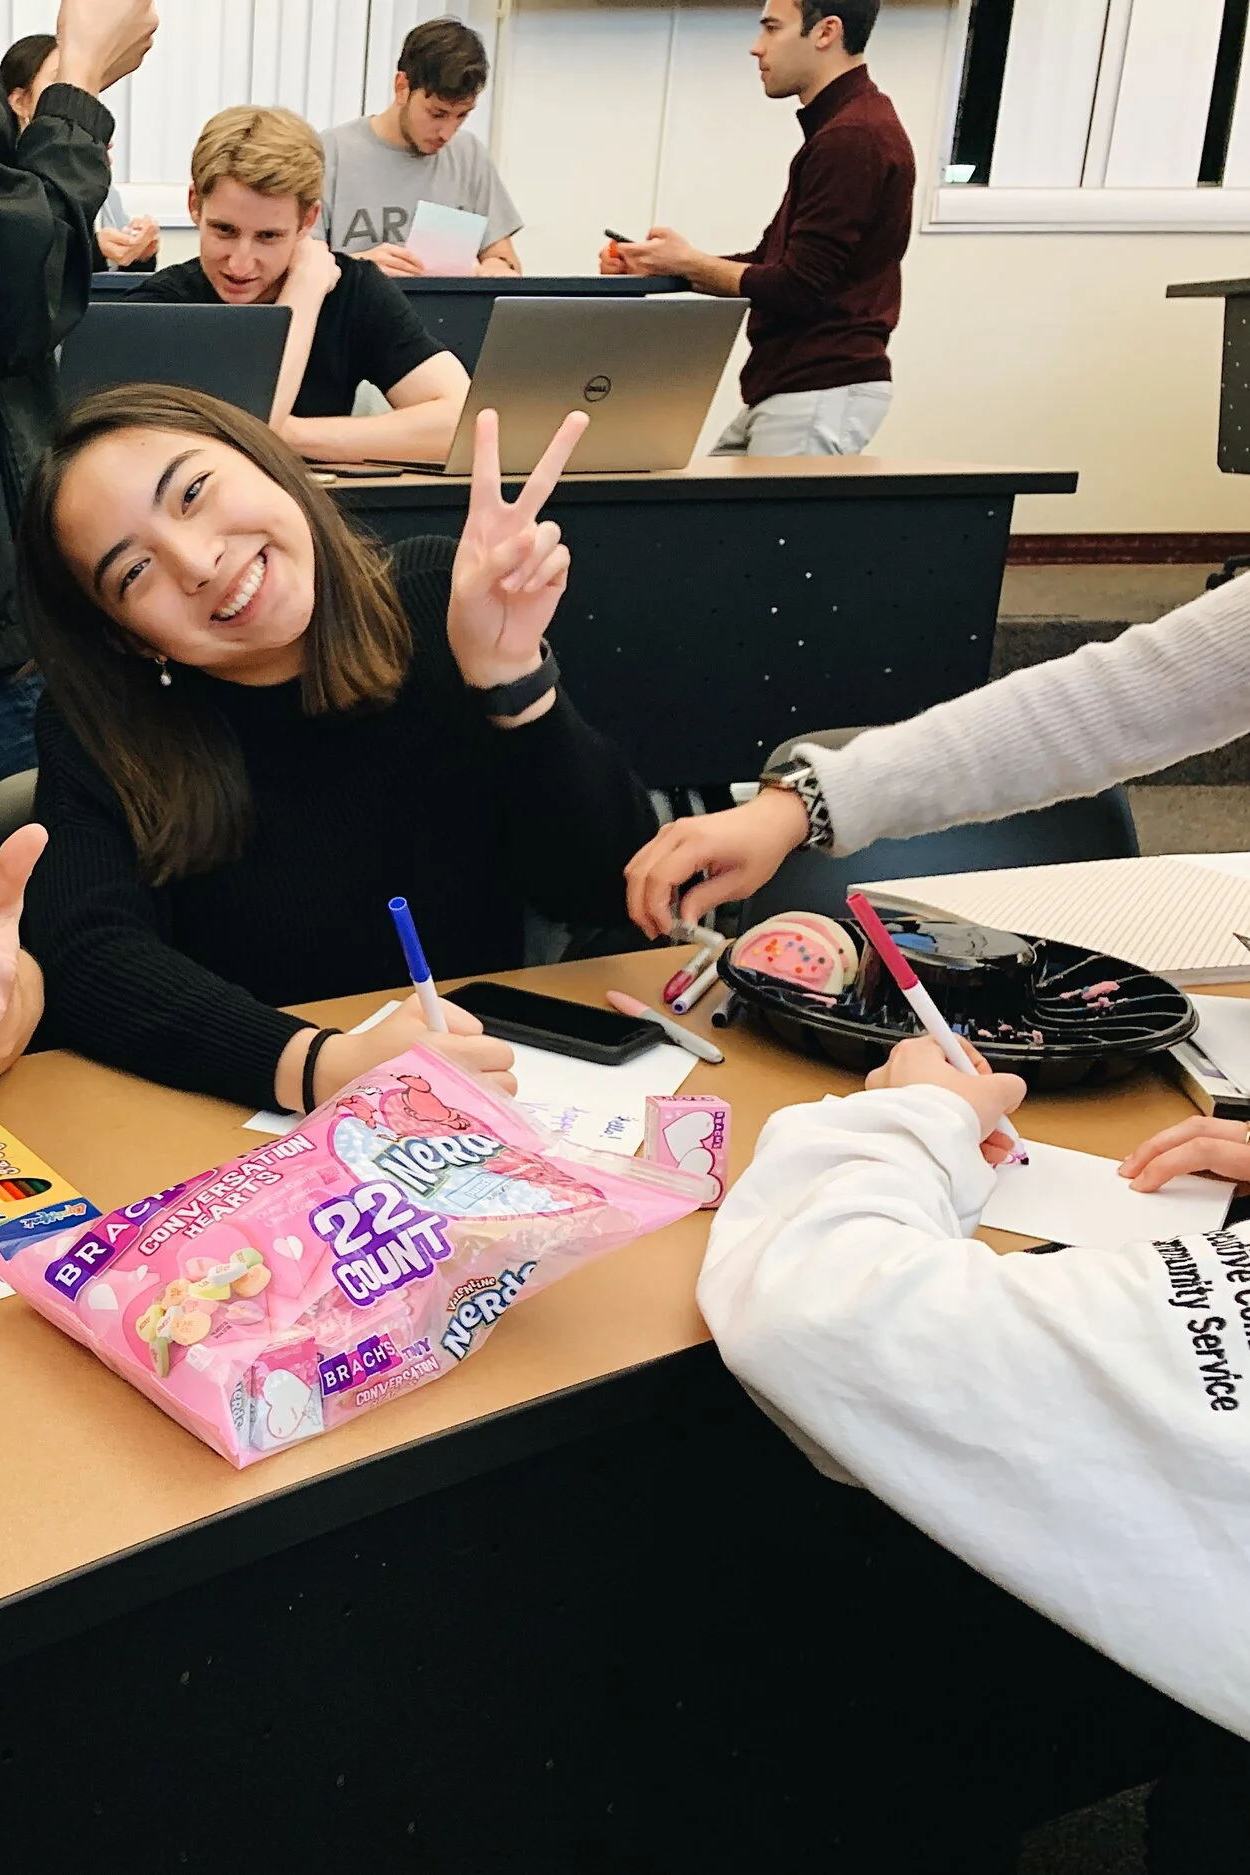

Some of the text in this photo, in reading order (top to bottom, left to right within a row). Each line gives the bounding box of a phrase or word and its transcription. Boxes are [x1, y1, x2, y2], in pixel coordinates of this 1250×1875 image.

[138, 1133, 318, 1257] CONVERSATION
[183, 1170, 284, 1240] HEARTS
[311, 1182, 417, 1258] 22
[335, 1214, 449, 1302] COUNT
[324, 1341, 396, 1388] BRACH'S
[1187, 1315, 1244, 1412] Service
